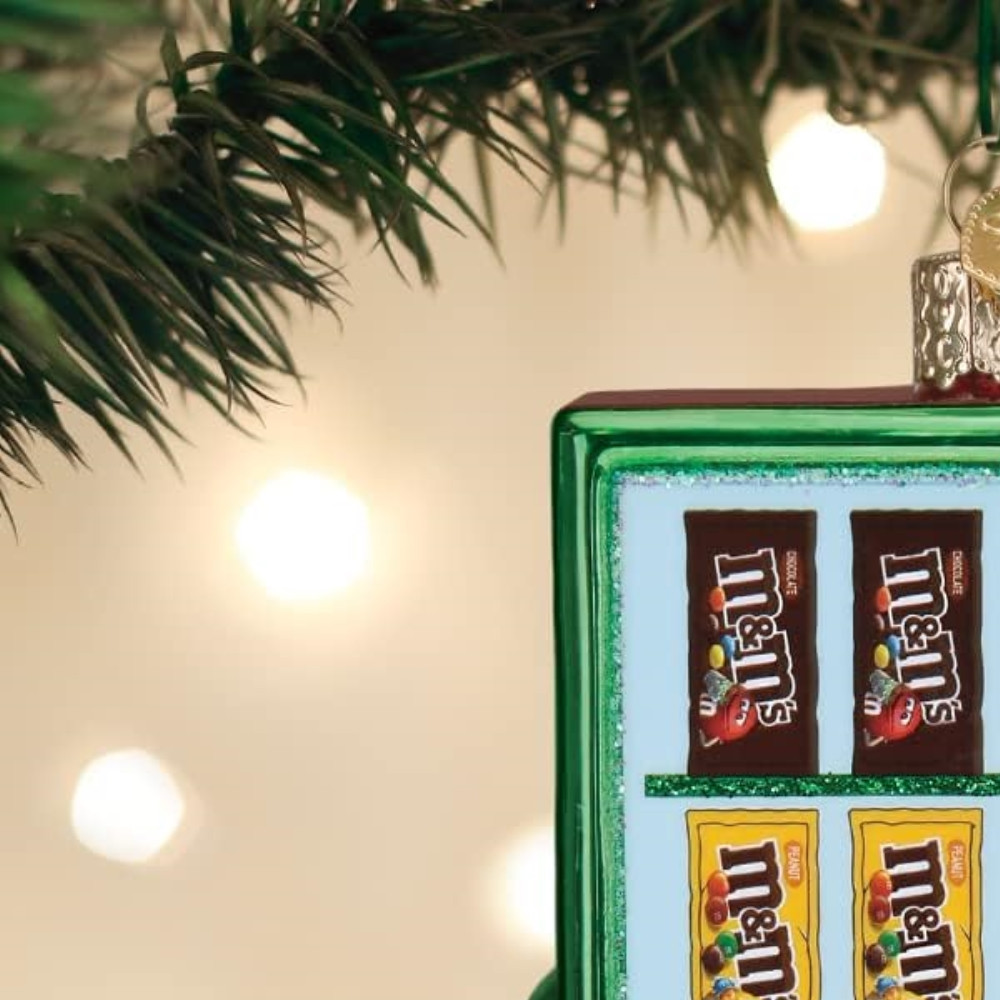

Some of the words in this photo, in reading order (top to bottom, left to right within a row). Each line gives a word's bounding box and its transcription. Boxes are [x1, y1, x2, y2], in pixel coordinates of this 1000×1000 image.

[786, 550, 798, 596] CHOCOLATE
[952, 549, 964, 596] CHOCOLATE
[787, 844, 800, 881] PEANUT
[952, 844, 965, 881] PEANUT
